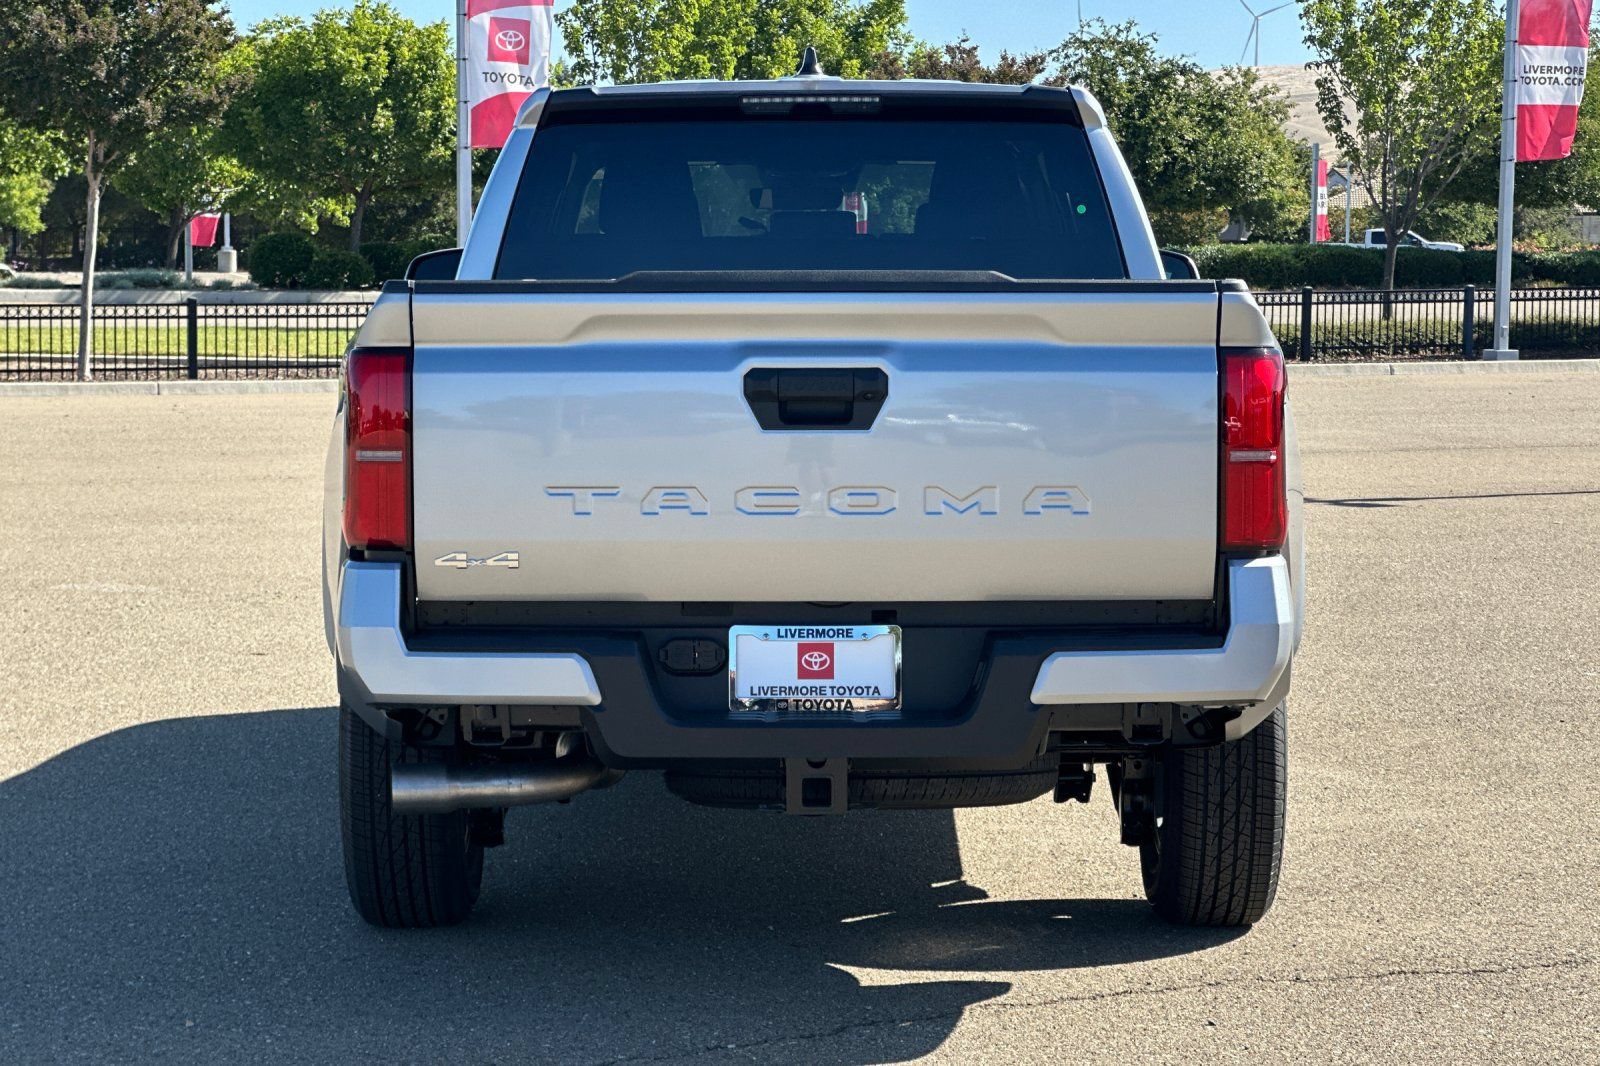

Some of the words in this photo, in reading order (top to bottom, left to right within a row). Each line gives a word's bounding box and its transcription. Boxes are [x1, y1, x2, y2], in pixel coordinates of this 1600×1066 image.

[1523, 65, 1585, 75] LIVERMORE
[482, 71, 534, 87] TOYOTA
[544, 485, 1092, 516] TACOMA
[434, 551, 519, 570] 4x4
[777, 628, 854, 639] LIVERMORE
[750, 686, 827, 697] LIVERMORE
[831, 686, 881, 697] TOYOTA
[792, 699, 854, 711] TOYOTA
